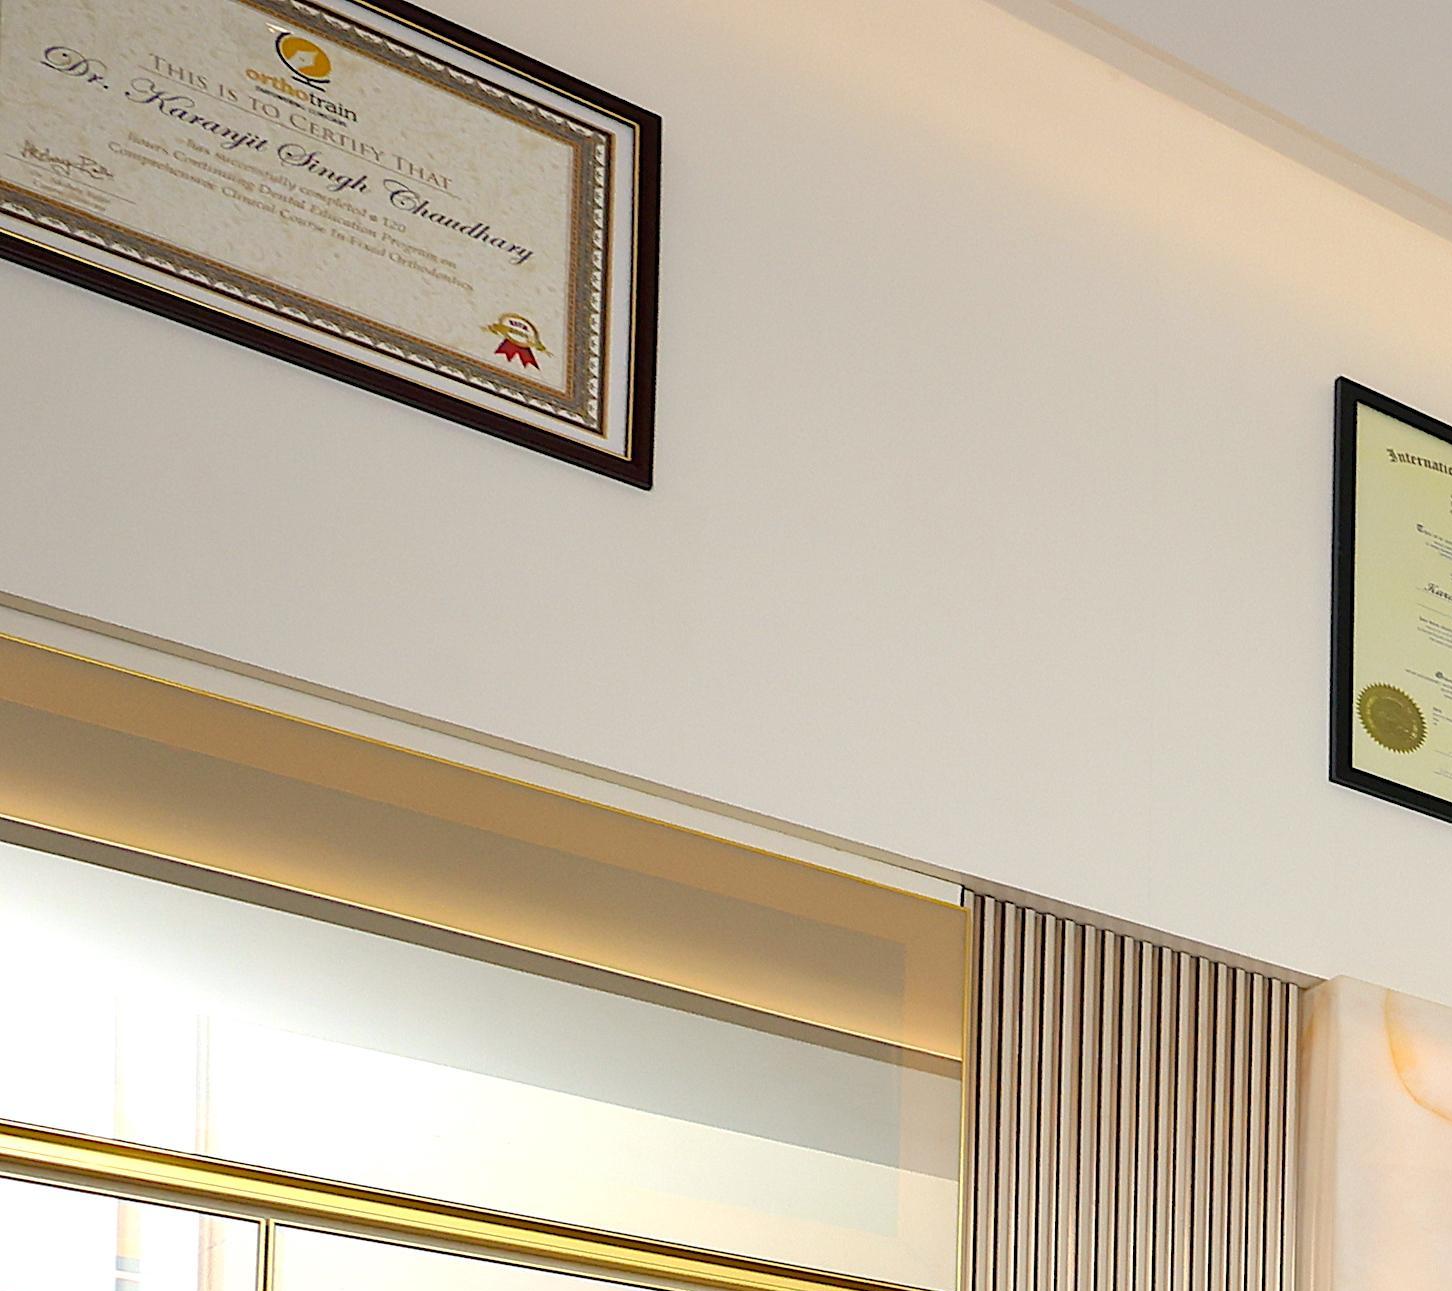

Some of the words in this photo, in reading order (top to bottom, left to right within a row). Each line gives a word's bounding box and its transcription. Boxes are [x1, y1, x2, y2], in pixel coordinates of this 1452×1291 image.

[41, 46, 109, 90] Dr.
[125, 77, 268, 150] Karanjit
[277, 143, 371, 193] Singh
[383, 179, 533, 265] Chaudhary
[150, 53, 208, 90] THIS
[290, 109, 385, 162] CERTIFY
[390, 153, 452, 191] THAT
[246, 69, 358, 122] orthotrain
